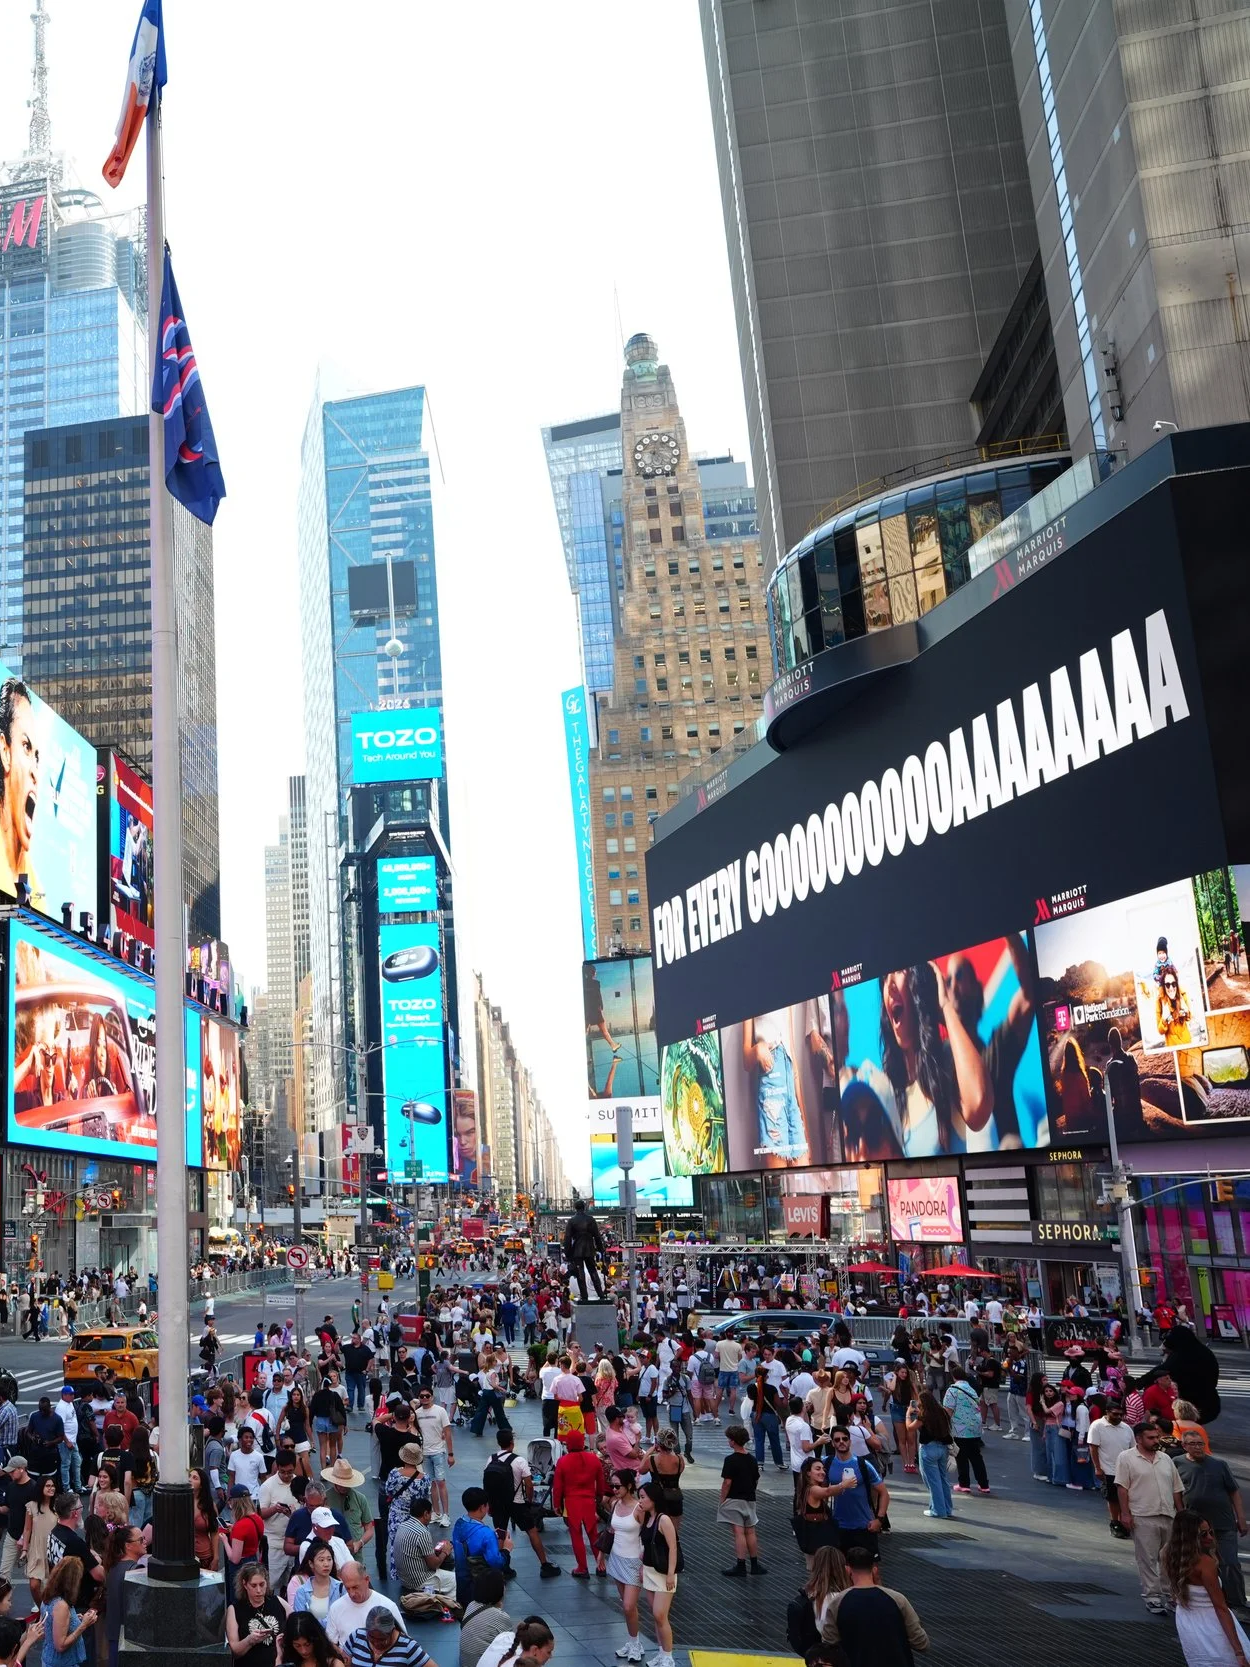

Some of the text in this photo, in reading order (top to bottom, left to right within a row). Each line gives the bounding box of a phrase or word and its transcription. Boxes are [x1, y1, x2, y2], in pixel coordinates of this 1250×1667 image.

[1015, 515, 1067, 561] MARRIOTT
[1018, 536, 1063, 577] MARQUIS
[773, 661, 814, 695] MARRIOTT
[774, 679, 810, 710] MARQUIS
[355, 727, 437, 750] TOZO
[362, 751, 436, 763] Tech Around You
[706, 770, 728, 791] MARRIOTT
[707, 784, 726, 801] MARQUIS
[1051, 884, 1088, 904] MARRIOTT
[652, 890, 688, 969] FOR
[686, 857, 743, 953] EVERY
[1052, 897, 1085, 916] MARQUIS
[841, 963, 863, 977] MARRIOTT
[841, 973, 861, 985] MARQUIS
[387, 1000, 436, 1011] TOZO
[1084, 1001, 1107, 1013] National
[1085, 1012, 1099, 1023] Park
[598, 1107, 659, 1121] SUMIT
[1049, 1150, 1082, 1162] SEPHORA
[900, 1200, 947, 1216] PANDORA
[1039, 1224, 1101, 1241] SEPHORA
